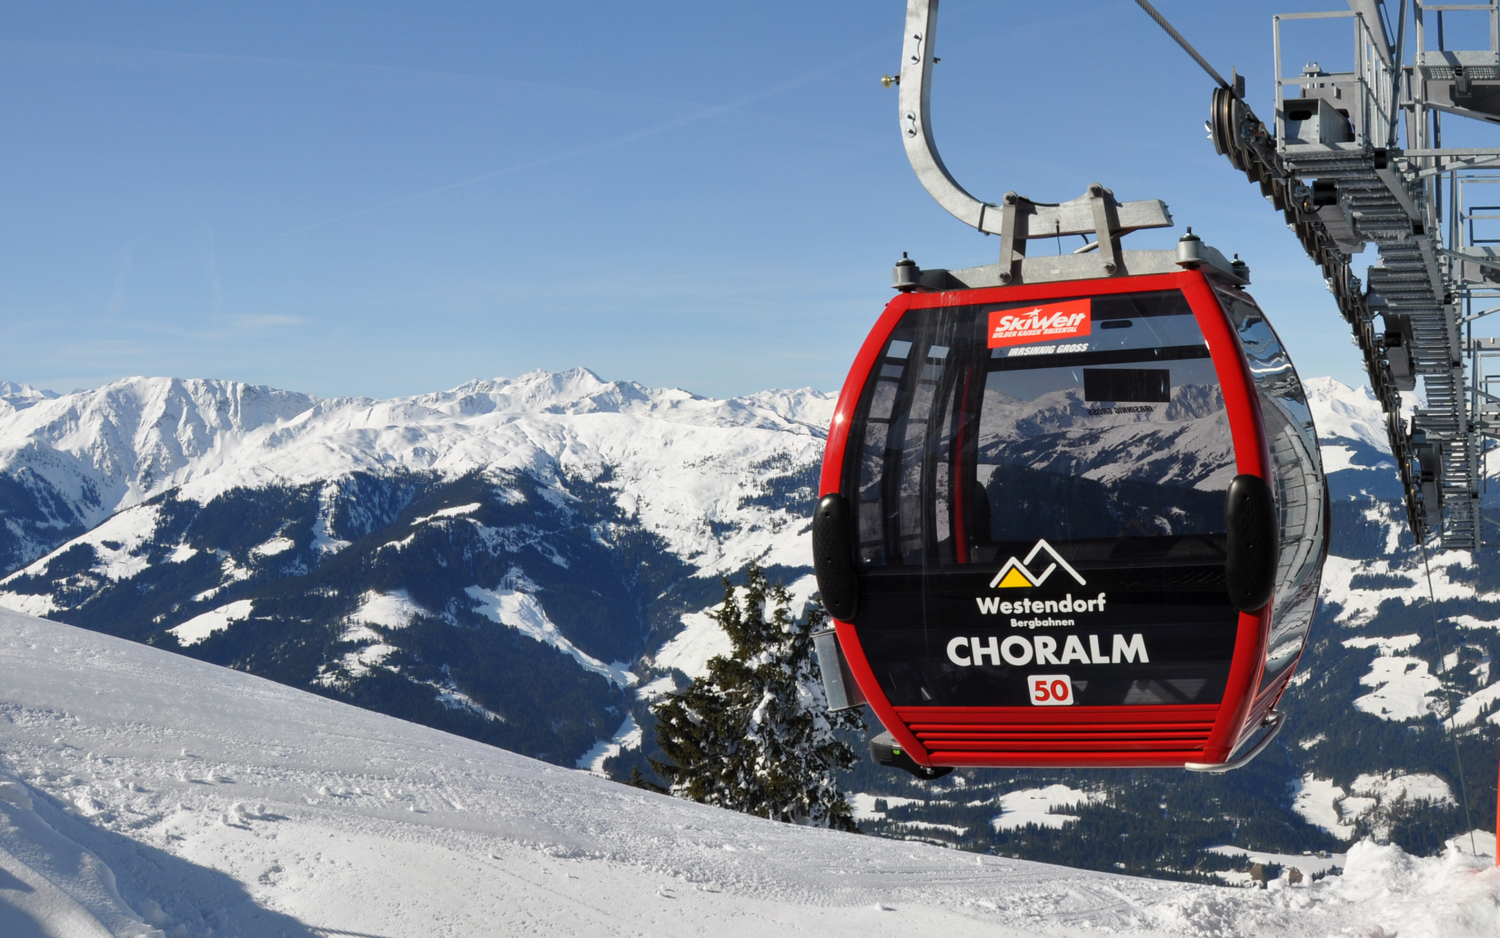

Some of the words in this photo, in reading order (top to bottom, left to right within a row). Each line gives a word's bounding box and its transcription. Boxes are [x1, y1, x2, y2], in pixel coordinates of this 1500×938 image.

[995, 309, 1086, 332] SkiWelt
[992, 331, 1018, 339] WILDER
[1017, 329, 1042, 337] KAISER
[1042, 326, 1078, 335] BRIXENTAL
[1007, 345, 1056, 357] IRRSINNIG
[1056, 343, 1089, 354] GROSS
[976, 592, 1106, 614] Westendorf
[1010, 617, 1075, 629] Bergbahnen
[946, 633, 1150, 667] CHORALM
[1034, 679, 1069, 702] 50
